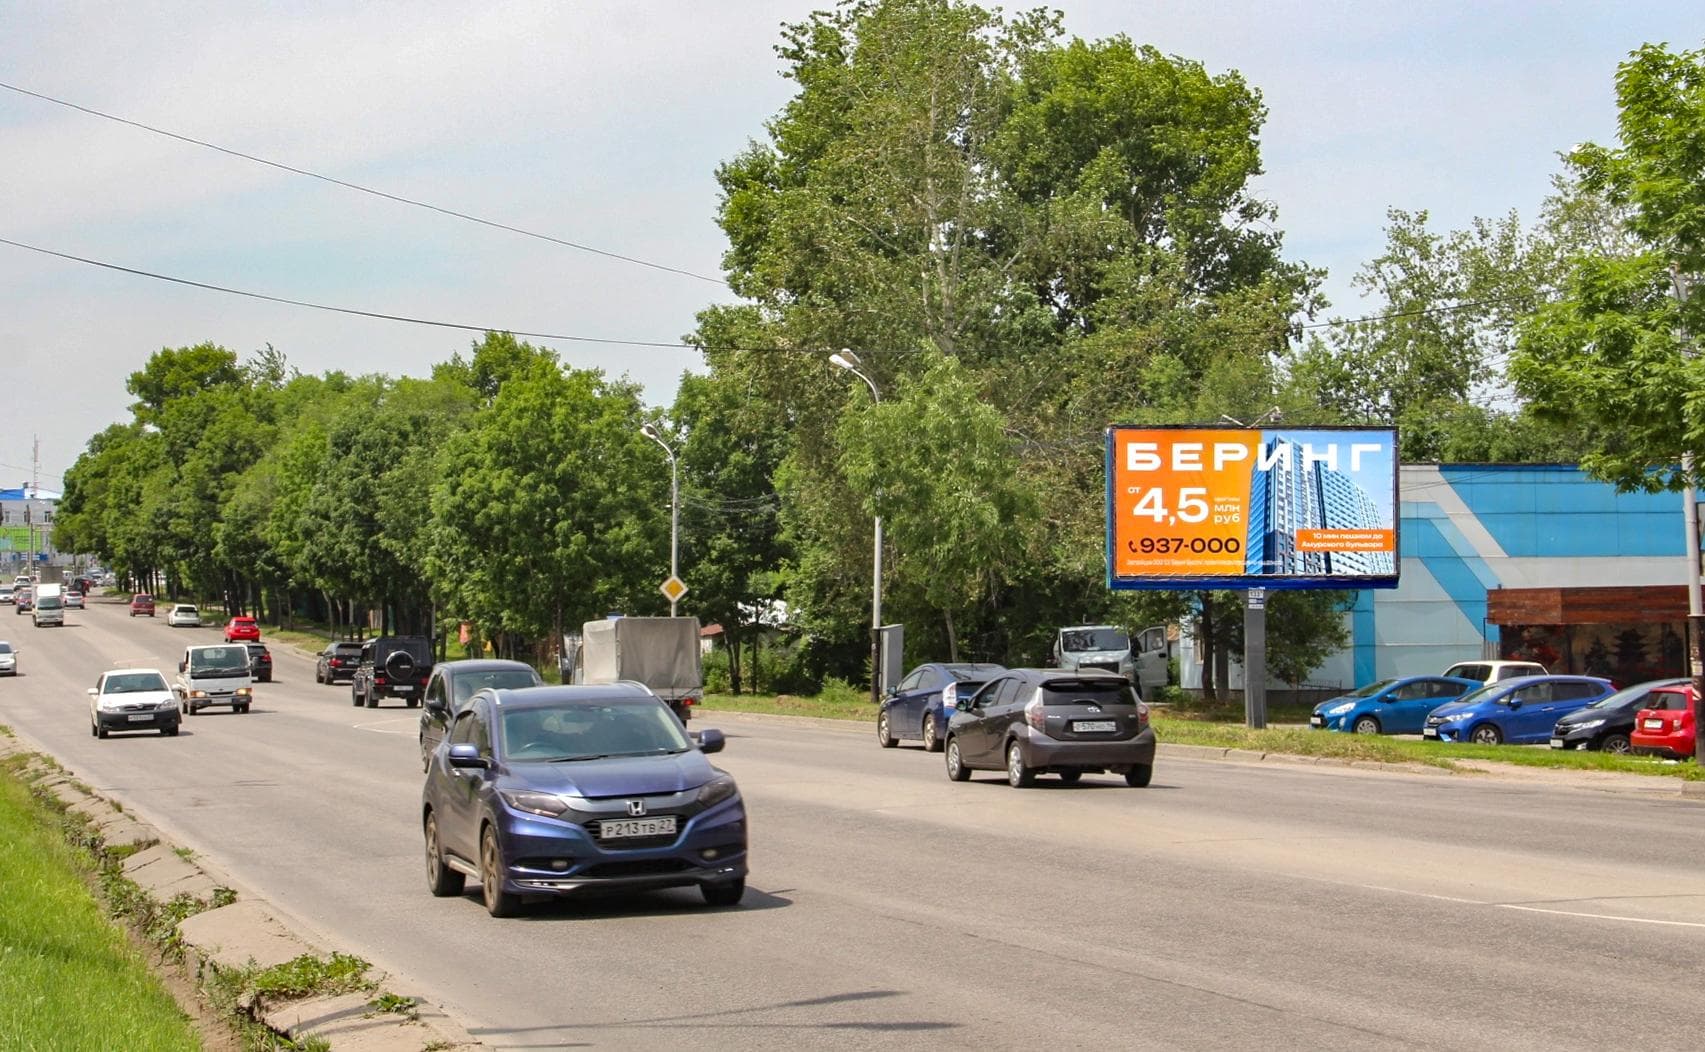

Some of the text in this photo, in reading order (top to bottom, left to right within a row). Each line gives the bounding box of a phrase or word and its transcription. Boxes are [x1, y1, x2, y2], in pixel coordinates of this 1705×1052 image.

[1127, 443, 1381, 471] БЕРИНГ
[1133, 487, 1209, 526] 4,5
[1214, 504, 1240, 513] млн
[1214, 513, 1240, 524] руб
[1140, 537, 1241, 554] 937-000
